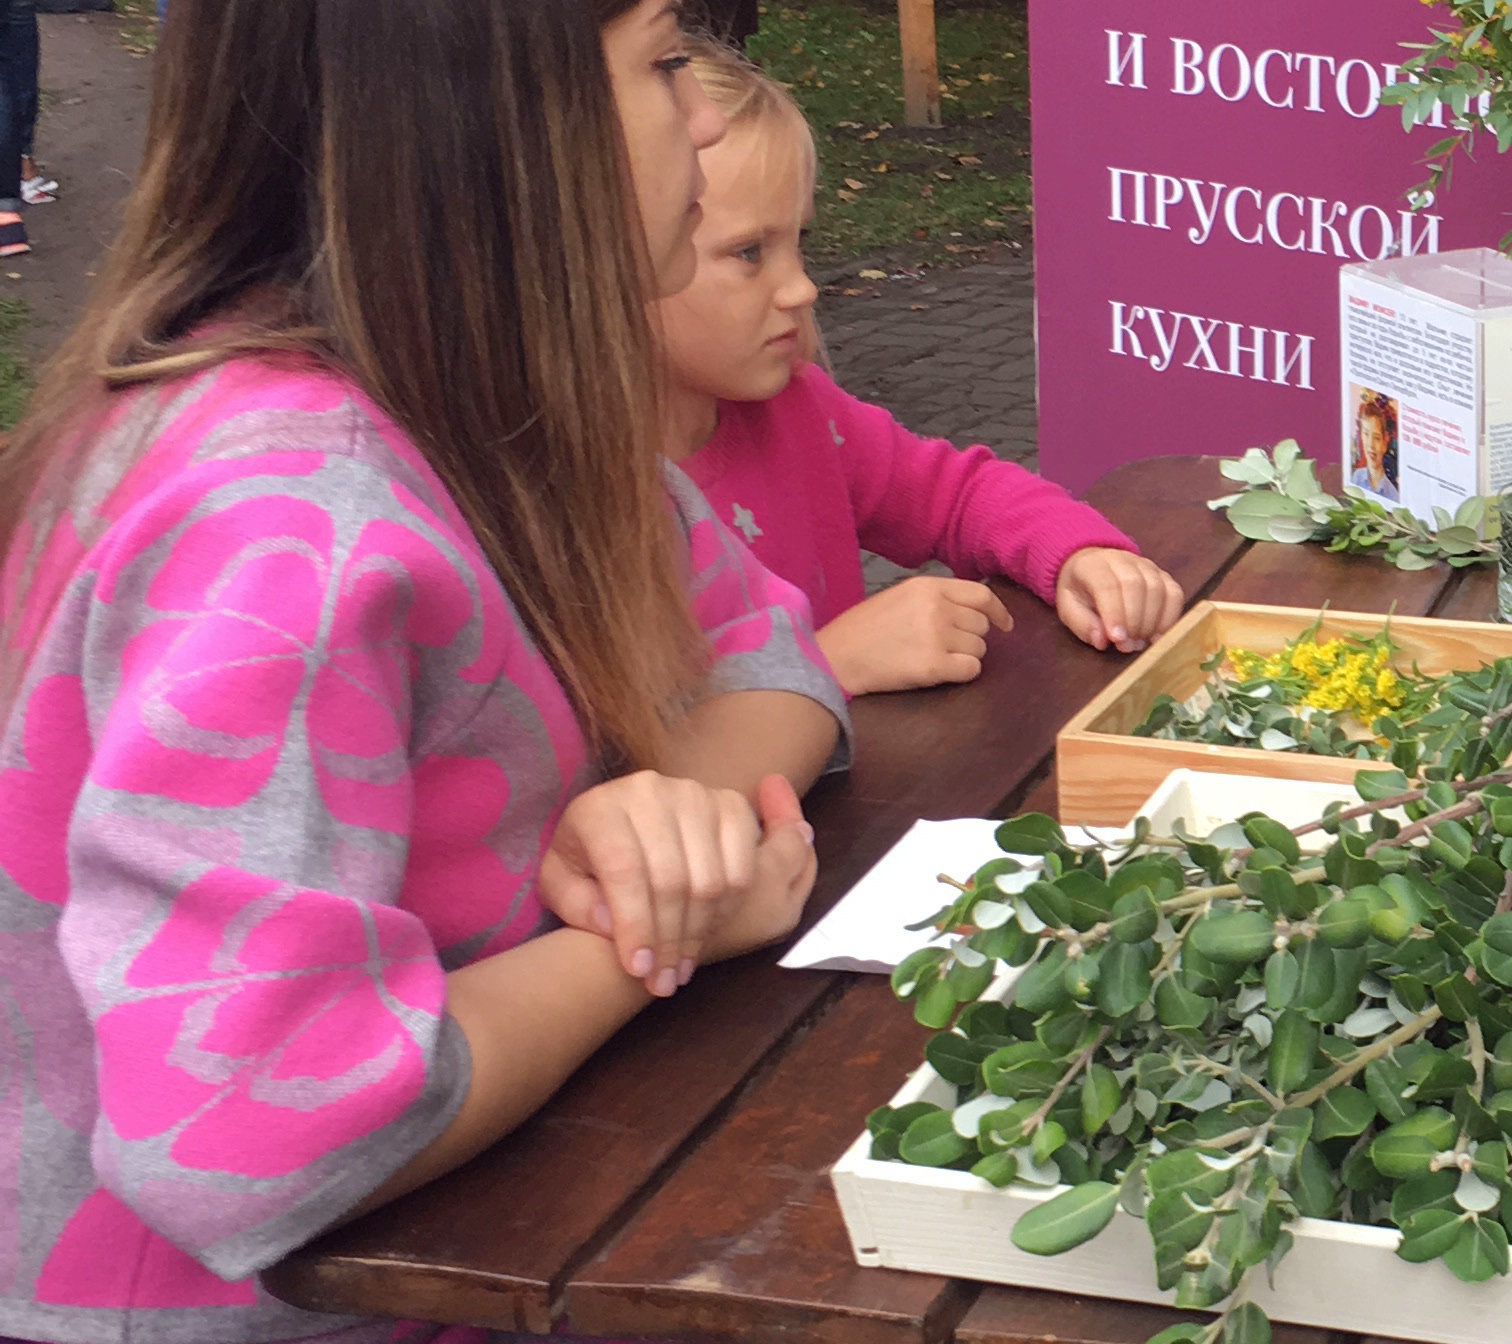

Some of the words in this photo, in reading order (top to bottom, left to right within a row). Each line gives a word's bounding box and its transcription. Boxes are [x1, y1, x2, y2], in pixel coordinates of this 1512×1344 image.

[1104, 29, 1147, 88] И
[1106, 166, 1444, 262] ПРУССКОЙ
[1108, 300, 1316, 390] КУХНИ
